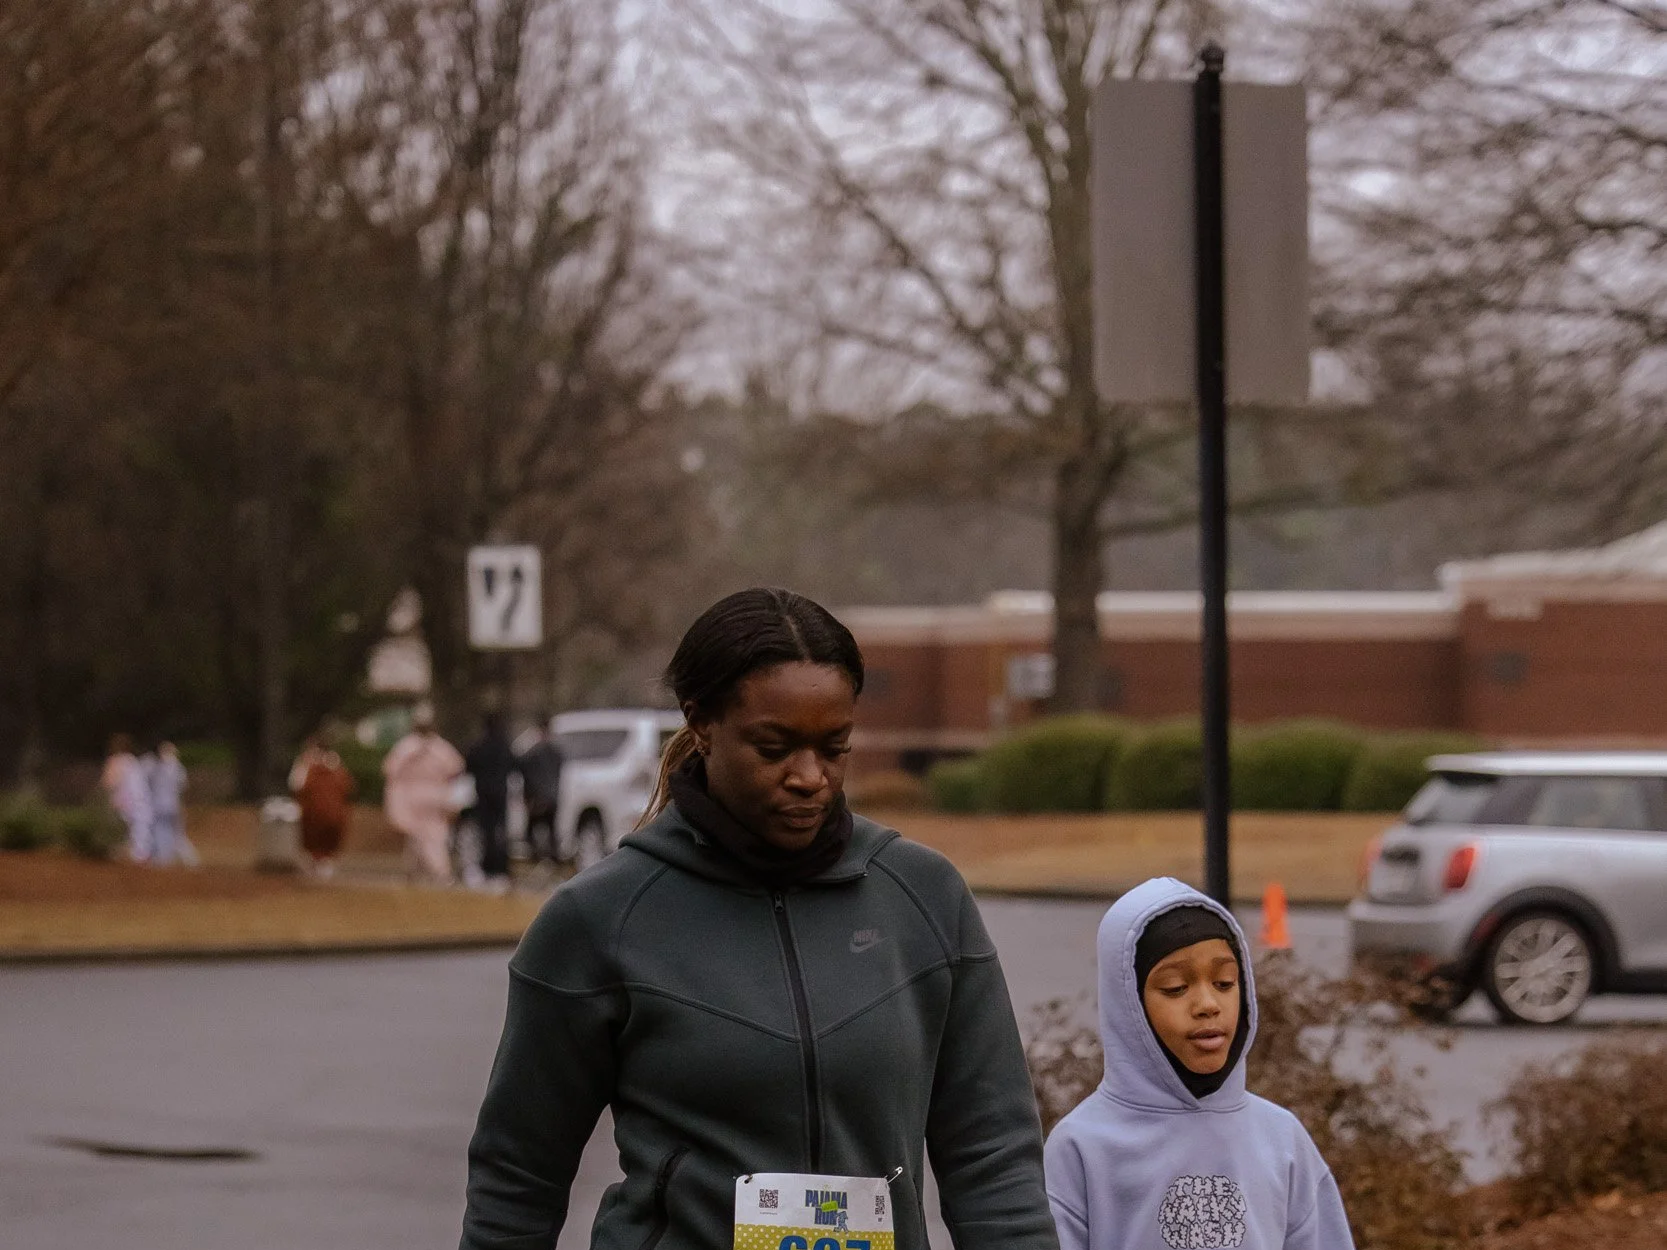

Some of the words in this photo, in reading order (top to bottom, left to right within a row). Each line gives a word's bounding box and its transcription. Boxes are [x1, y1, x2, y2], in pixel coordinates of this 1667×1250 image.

[1174, 1175, 1233, 1197] THE
[814, 1208, 837, 1225] RUN
[1162, 1221, 1246, 1249] WASH
